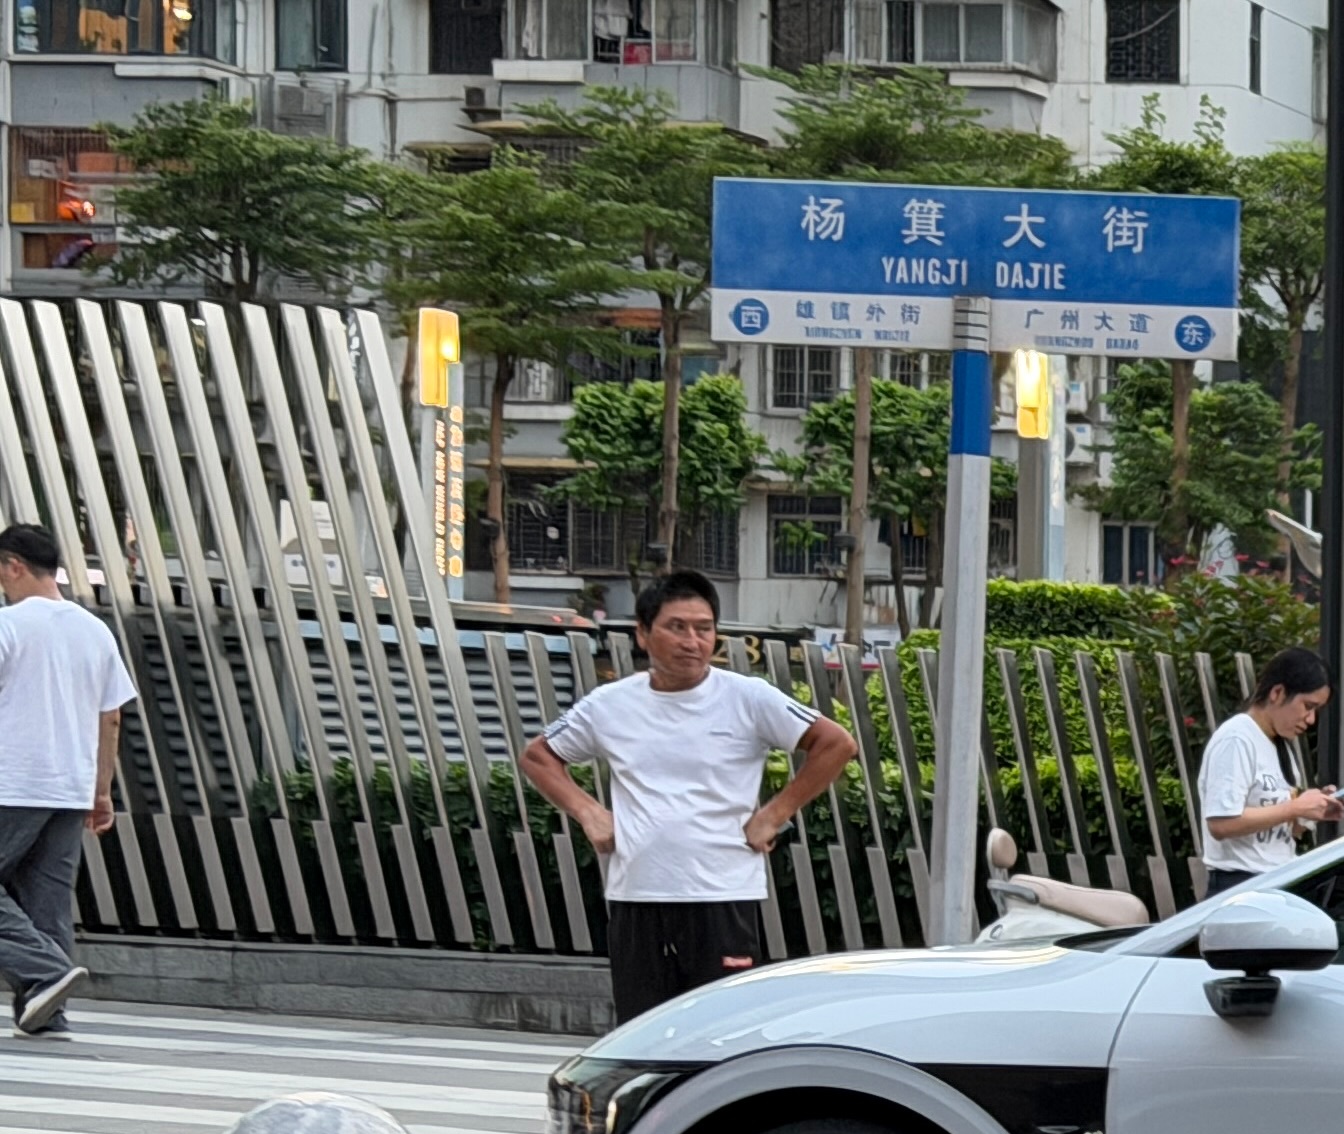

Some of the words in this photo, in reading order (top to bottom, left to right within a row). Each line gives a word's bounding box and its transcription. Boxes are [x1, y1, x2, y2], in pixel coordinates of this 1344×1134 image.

[800, 195, 1149, 254] 杨箕大街
[881, 256, 968, 287] YANGJI
[996, 261, 1067, 290] DAJIE
[1024, 308, 1154, 334] 广州大道
[1181, 322, 1204, 346] 东
